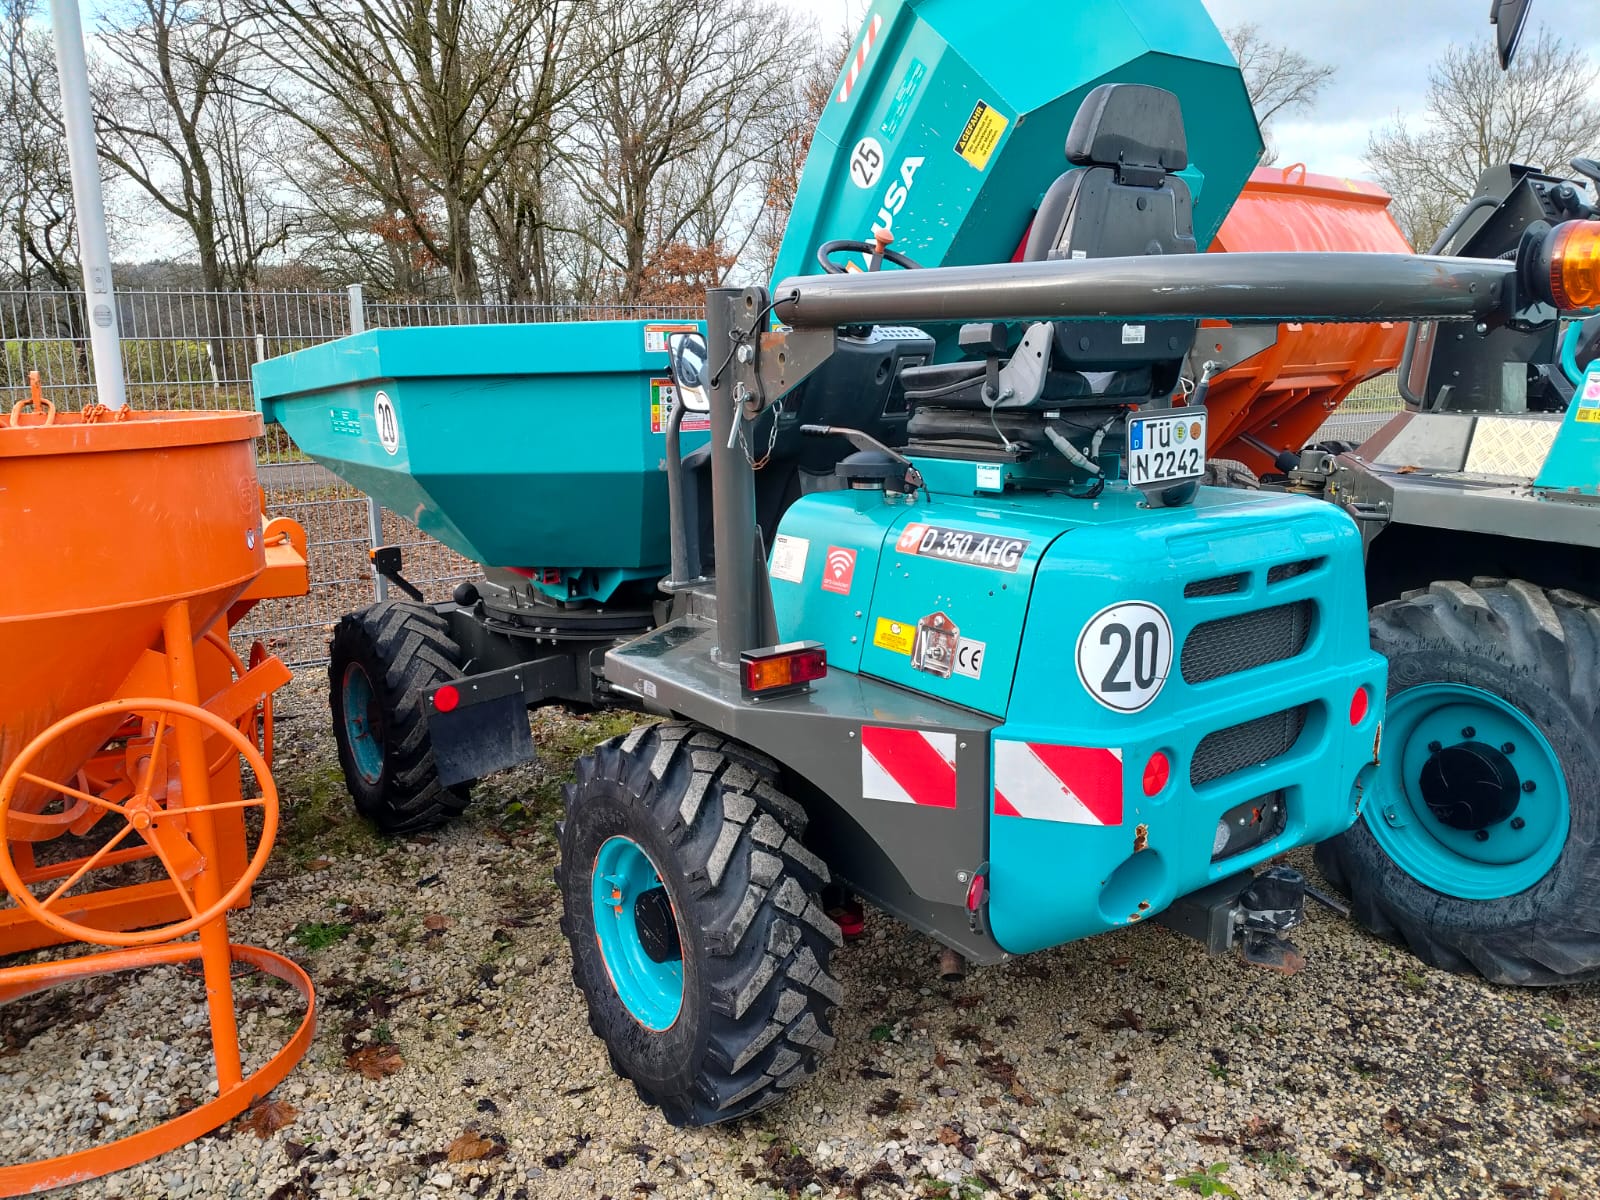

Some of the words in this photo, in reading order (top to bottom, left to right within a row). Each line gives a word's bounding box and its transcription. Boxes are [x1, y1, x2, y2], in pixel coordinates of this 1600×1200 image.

[962, 106, 984, 141] GEFAHR
[852, 142, 880, 185] 25
[378, 403, 395, 443] 20
[1146, 422, 1170, 449] TÜ
[1134, 439, 1139, 448] D
[1137, 454, 1149, 480] N
[1154, 448, 1199, 478] 2242
[919, 528, 938, 552] D
[936, 531, 973, 557] 350
[970, 537, 1022, 567] AHG
[959, 646, 981, 671] CE
[1100, 622, 1159, 692] 20
